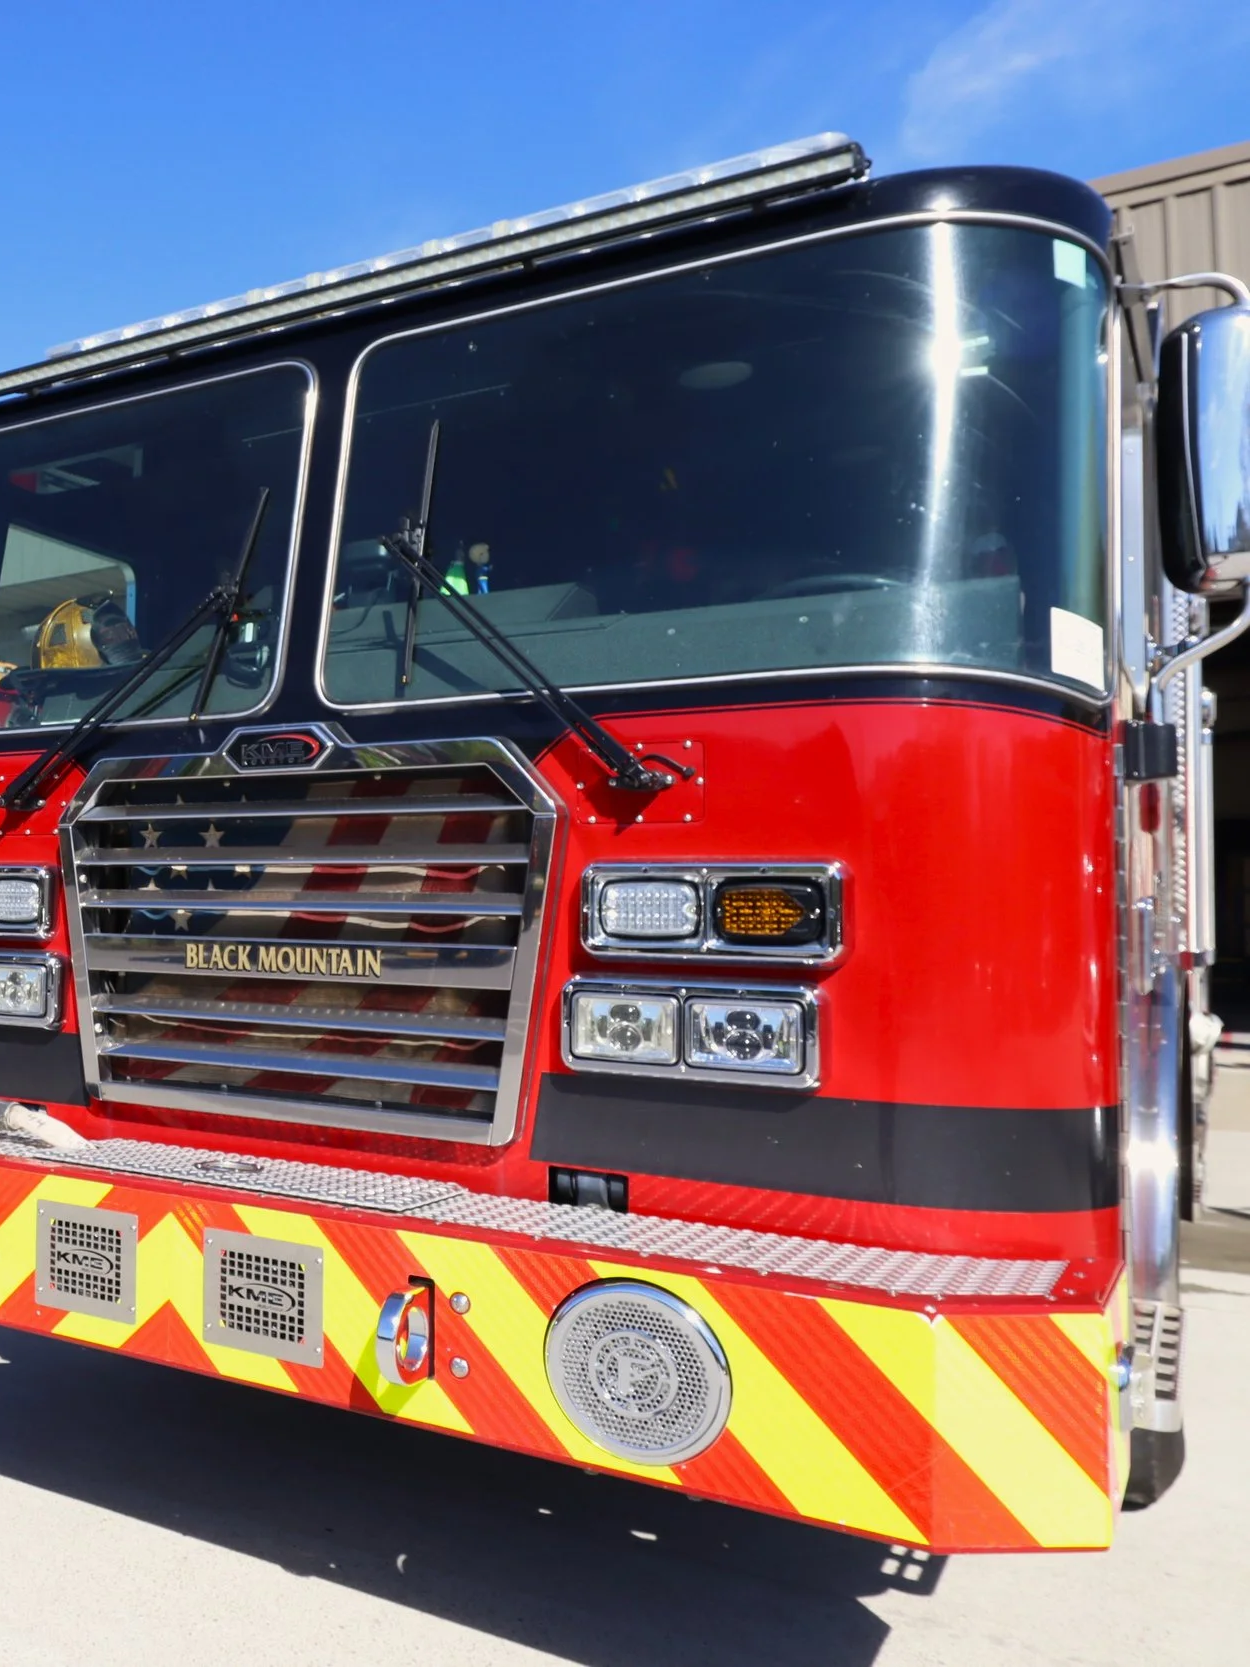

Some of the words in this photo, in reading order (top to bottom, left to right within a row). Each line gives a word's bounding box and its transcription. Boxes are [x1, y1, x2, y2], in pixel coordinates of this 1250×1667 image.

[240, 741, 305, 759] KME
[185, 943, 252, 972] BLACK
[256, 945, 382, 977] MOUNTAIN
[57, 1250, 104, 1270] KME
[228, 1284, 284, 1307] KME
